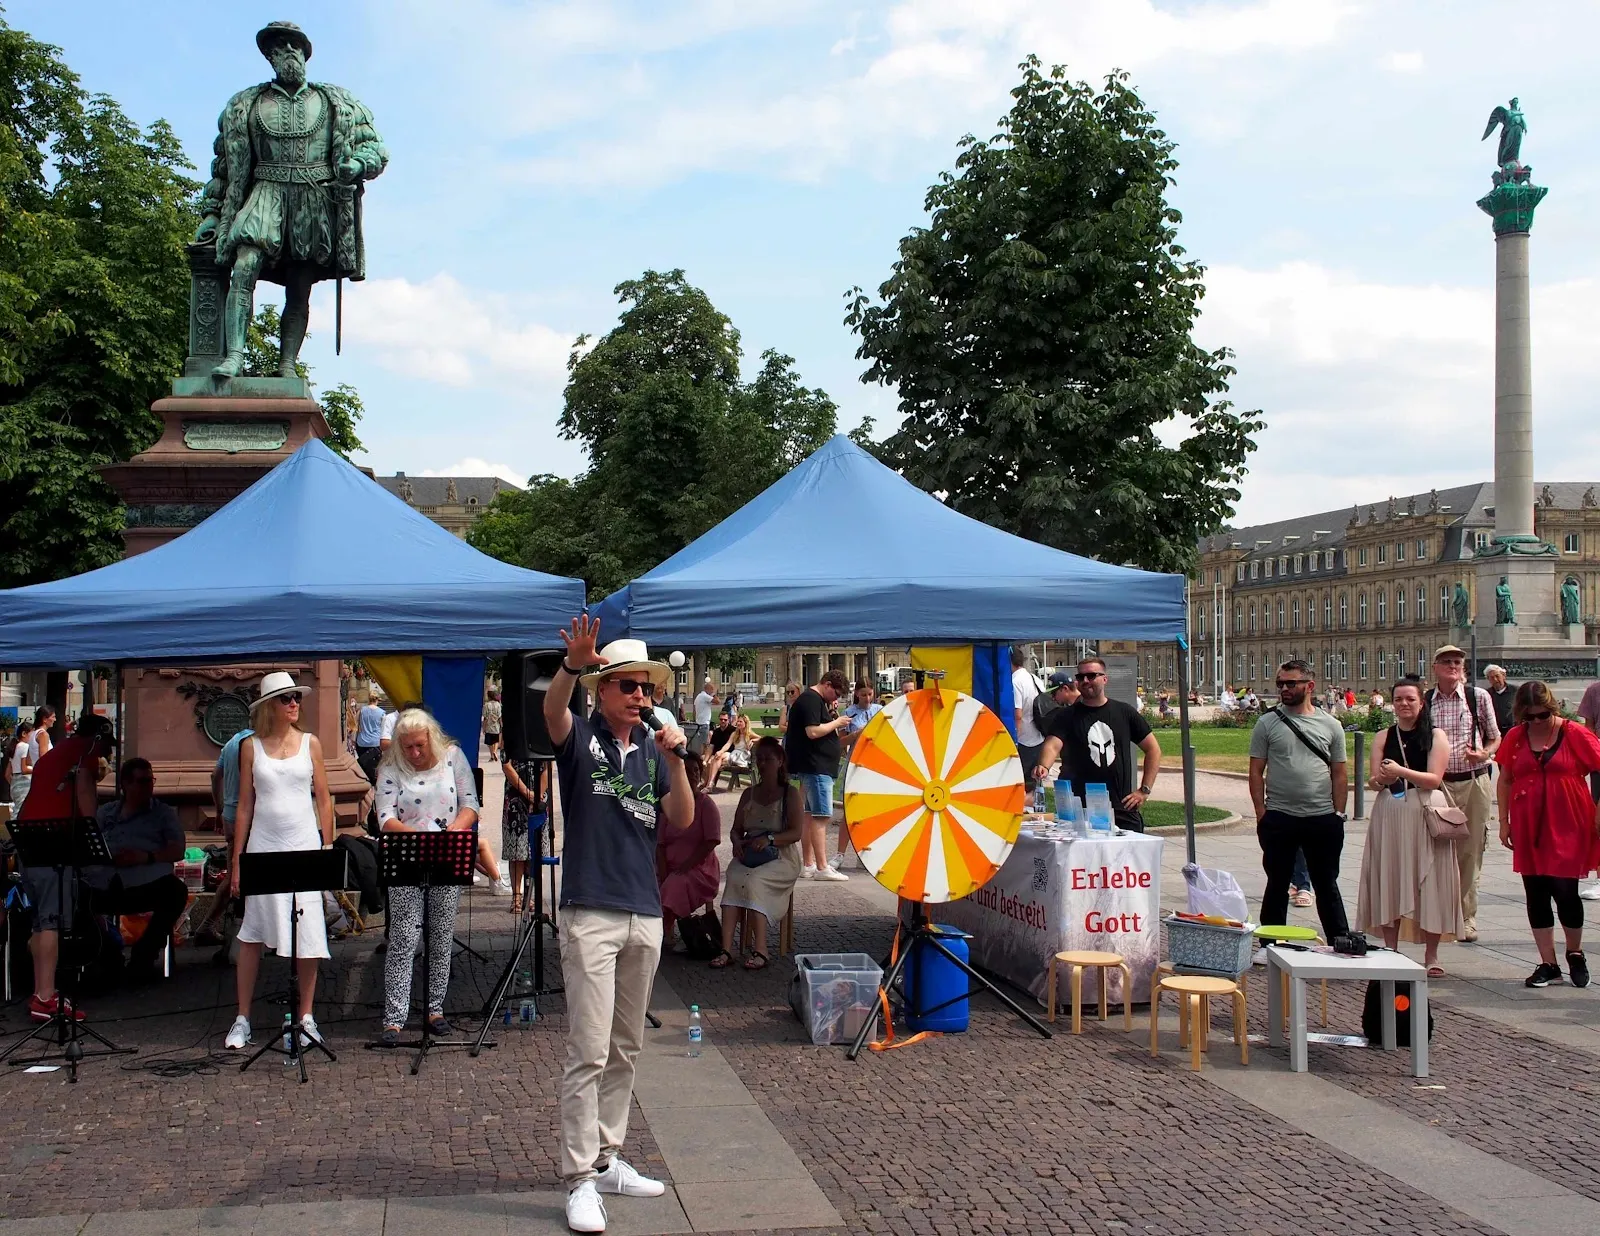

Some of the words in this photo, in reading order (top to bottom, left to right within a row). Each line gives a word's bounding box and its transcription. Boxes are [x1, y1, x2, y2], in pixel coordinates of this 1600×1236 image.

[594, 785, 616, 793] OFFICIA
[1071, 866, 1152, 890] Erlebe
[977, 885, 998, 912] und
[1000, 888, 1048, 931] befreit!
[1085, 911, 1142, 933] Gott
